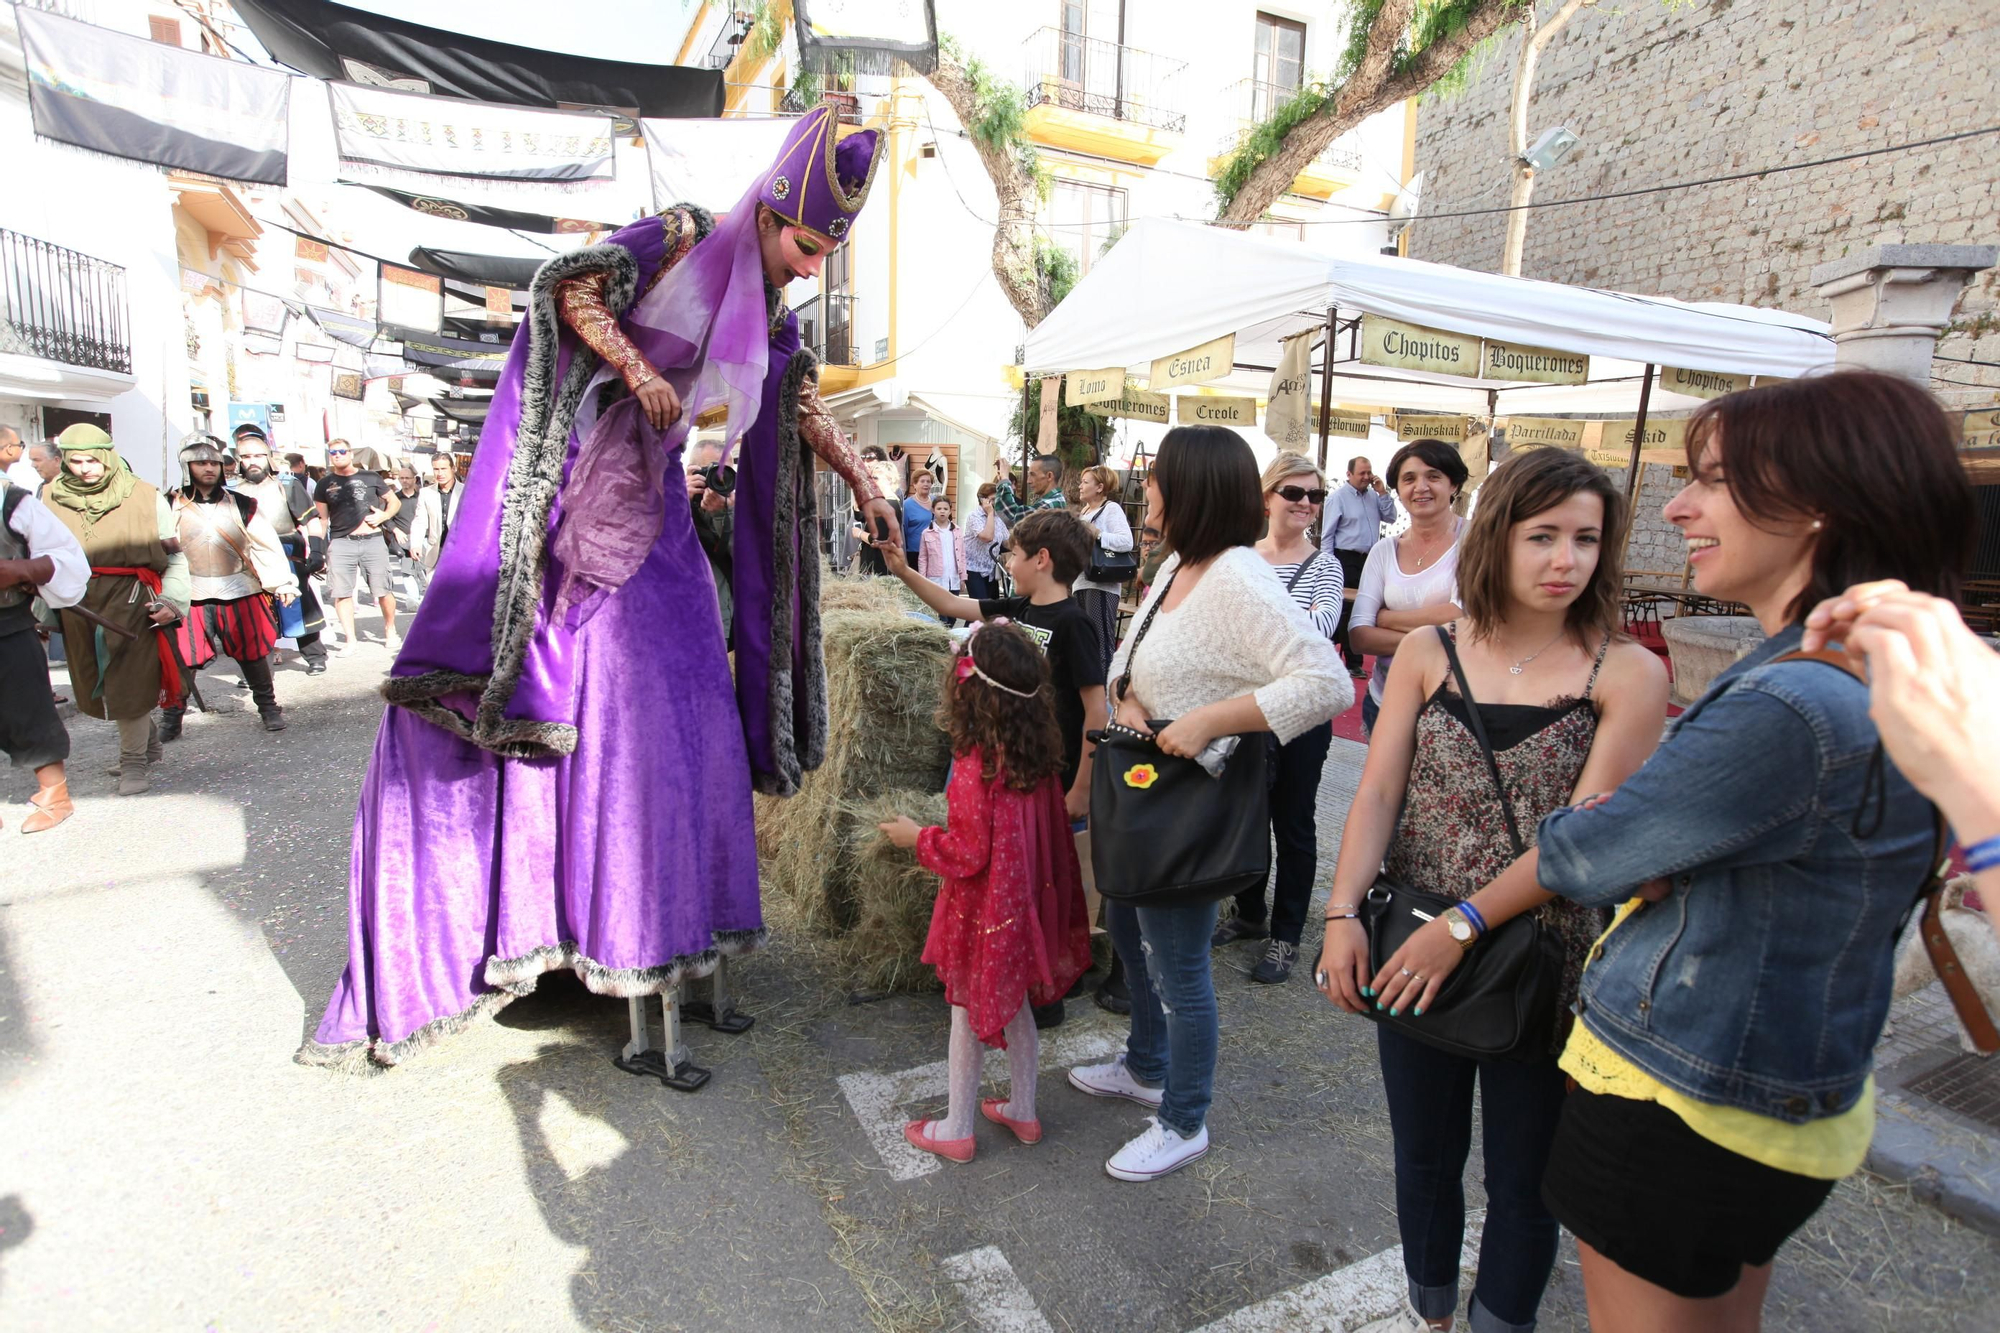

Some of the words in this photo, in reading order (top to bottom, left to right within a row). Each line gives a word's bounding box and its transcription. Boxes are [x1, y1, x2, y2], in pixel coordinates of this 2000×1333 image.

[1383, 330, 1460, 363] Chopitos
[1168, 356, 1211, 379] Esnea
[1489, 344, 1584, 375] Boquerones
[1079, 379, 1106, 395] Lomo
[1676, 367, 1735, 393] Chopitos
[1088, 399, 1166, 417] oquerones
[1196, 404, 1239, 420] Creole
[1402, 423, 1460, 437] Saiheskiak
[1510, 423, 1577, 442] Parrillada
